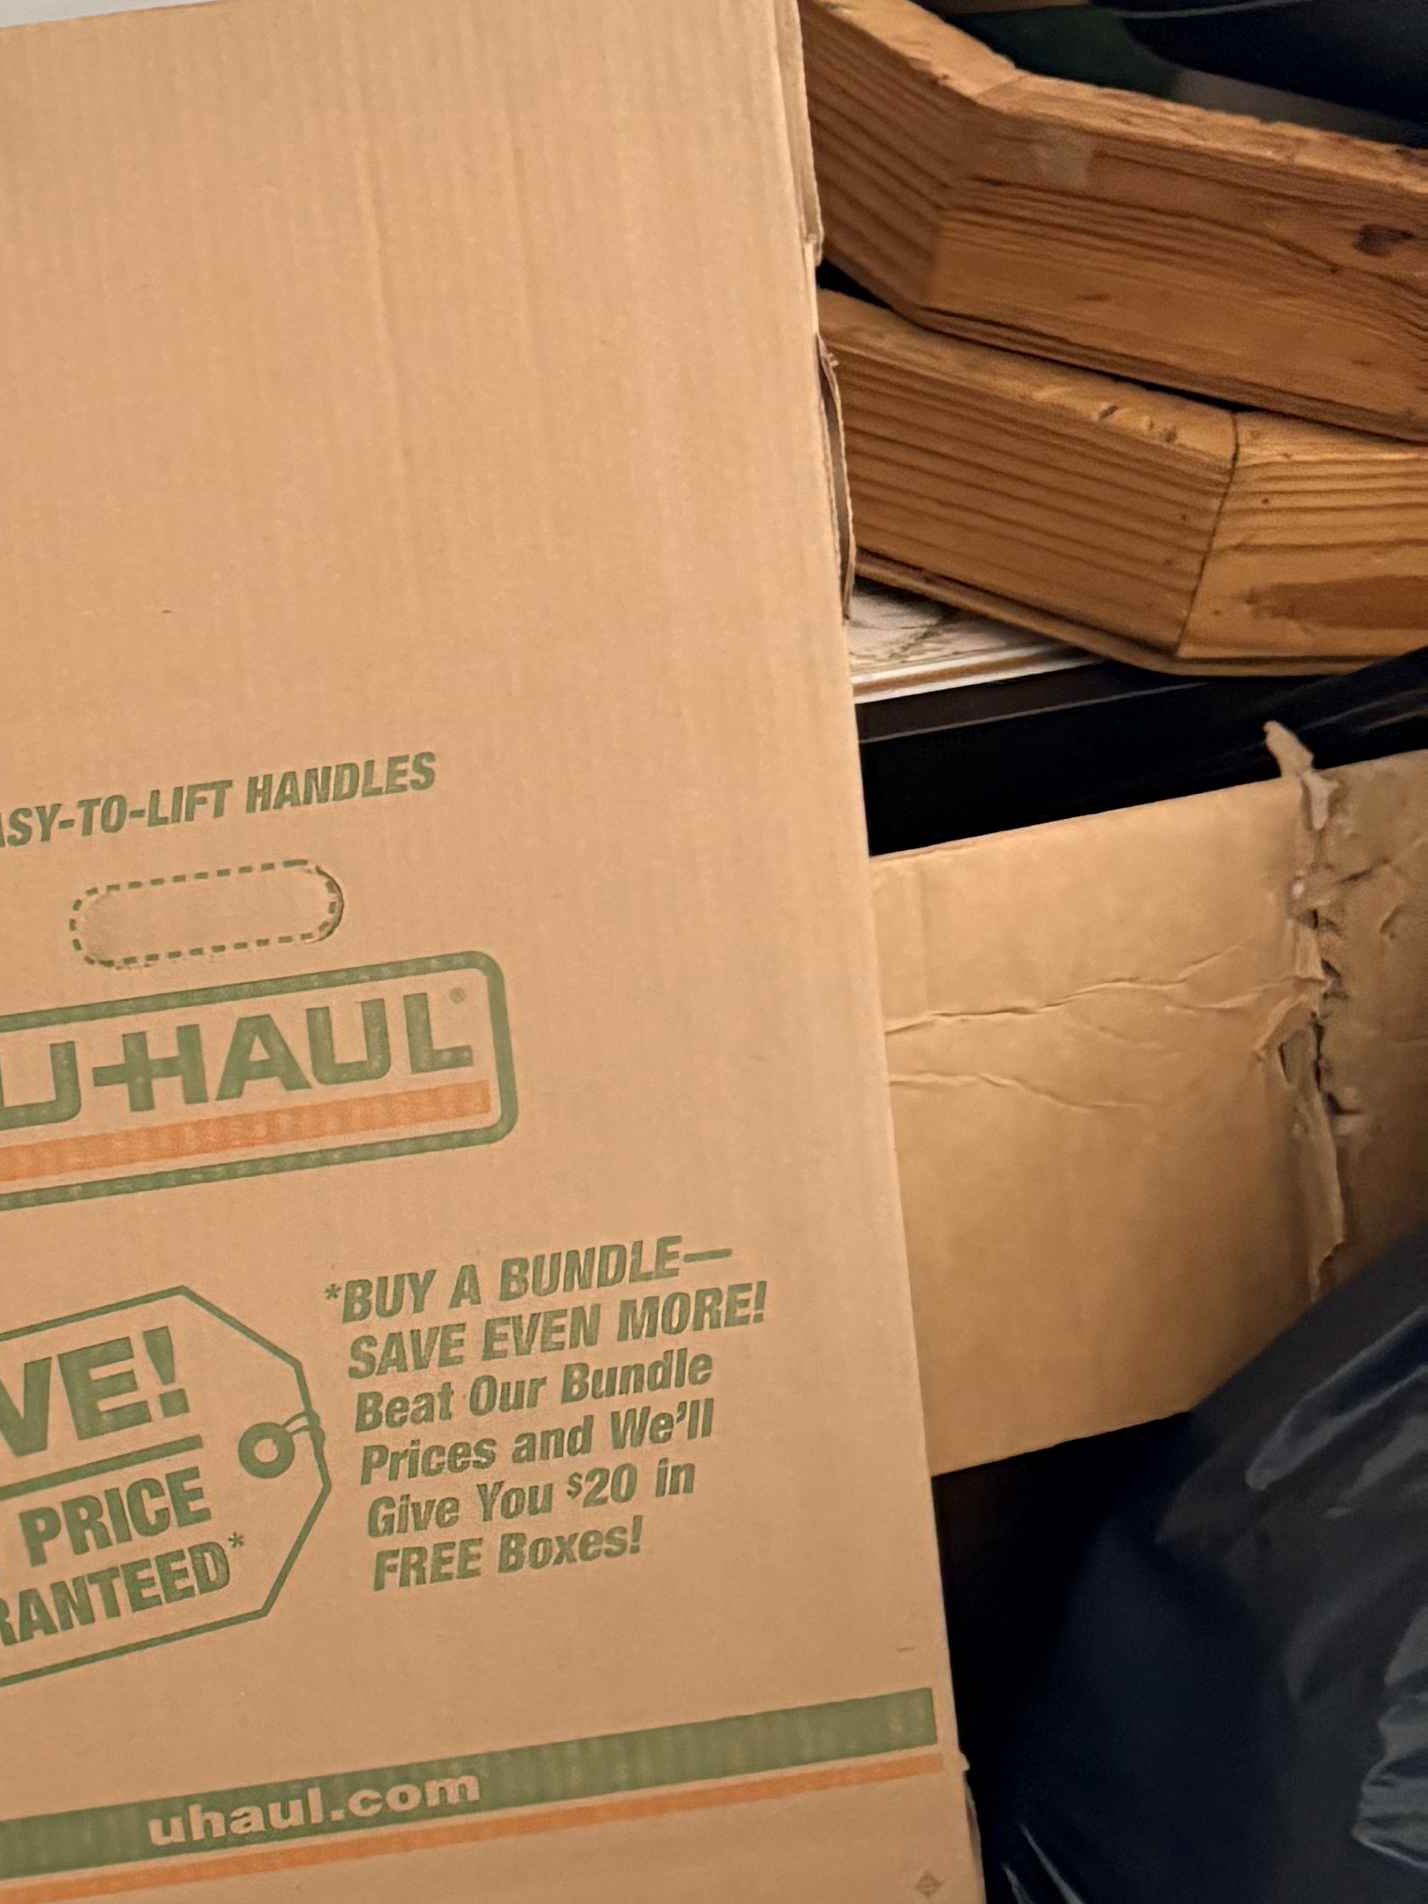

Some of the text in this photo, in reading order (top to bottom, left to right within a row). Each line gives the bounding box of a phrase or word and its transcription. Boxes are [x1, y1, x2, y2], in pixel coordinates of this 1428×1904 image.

[245, 751, 437, 814] HANDLES
[448, 1263, 481, 1309] A
[347, 1280, 768, 1380] SAVE EVEN MORE!
[355, 1347, 714, 1433] Beat Our Bundle
[360, 1436, 497, 1486] Prices
[511, 1414, 594, 1465] and
[19, 1466, 212, 1568] PRICE
[367, 1456, 696, 1539] Give You $20 in
[372, 1514, 644, 1592] FREE Boxes!
[147, 1770, 481, 1846] uhaul.com
